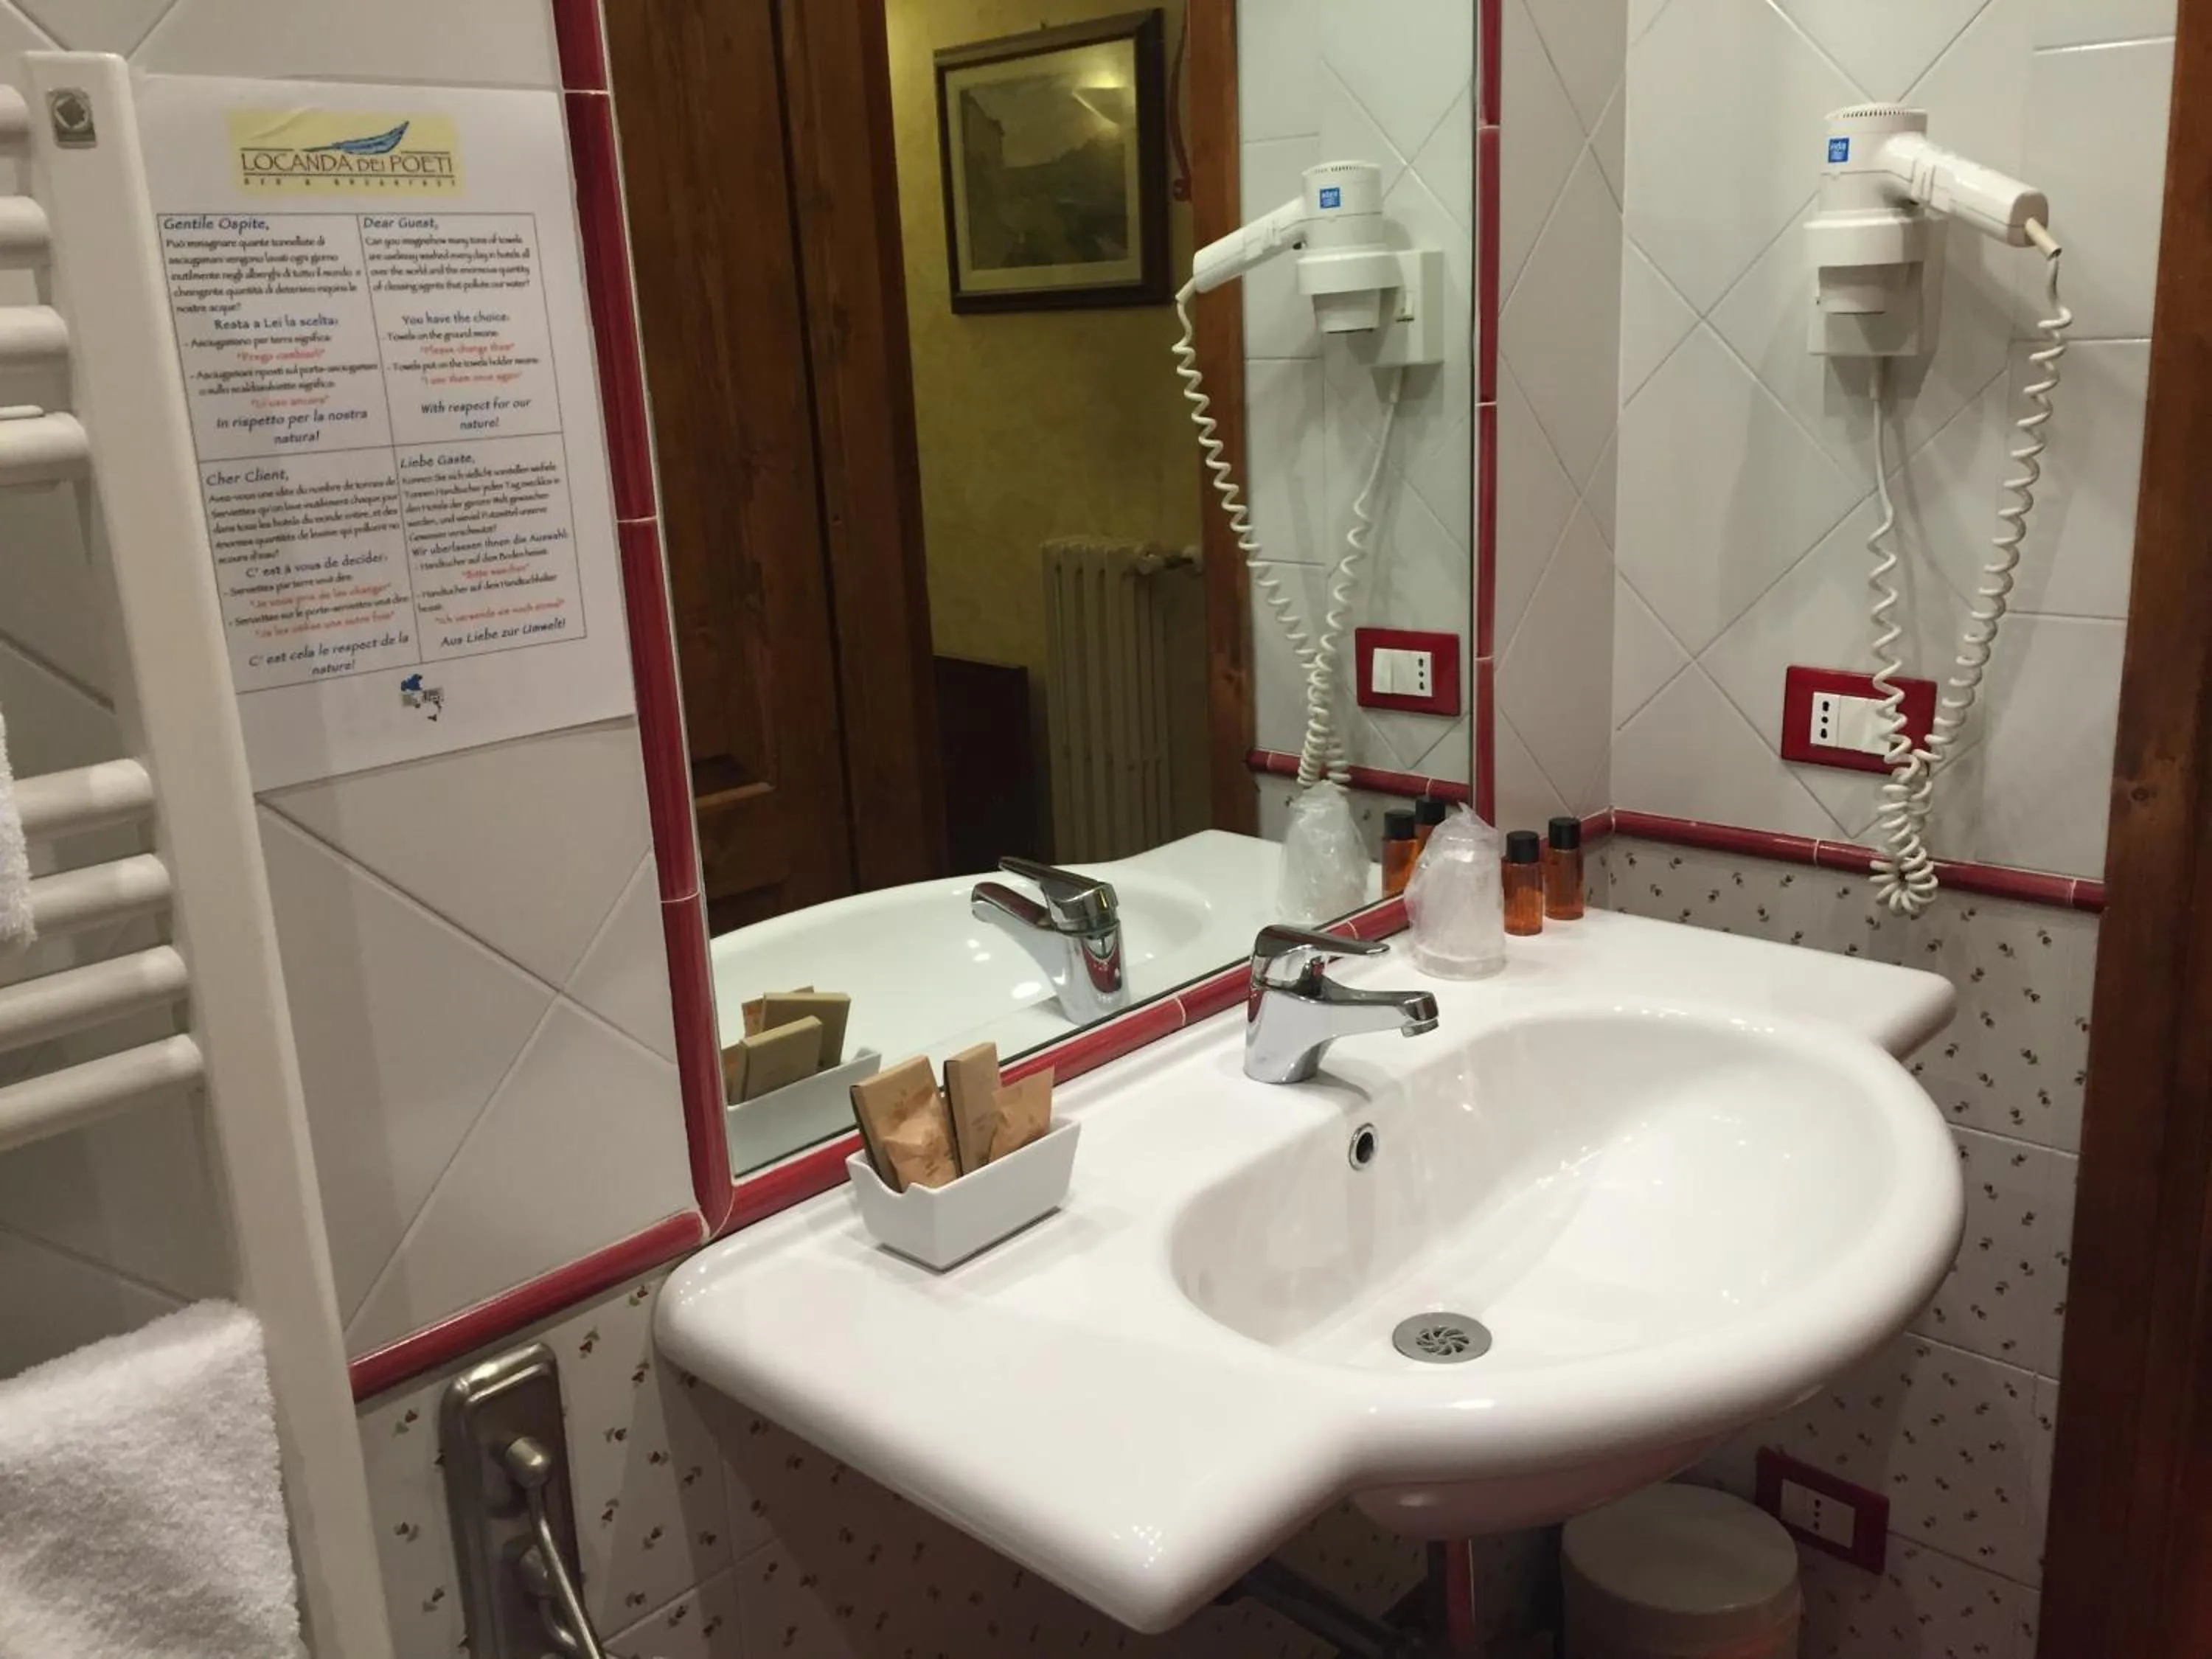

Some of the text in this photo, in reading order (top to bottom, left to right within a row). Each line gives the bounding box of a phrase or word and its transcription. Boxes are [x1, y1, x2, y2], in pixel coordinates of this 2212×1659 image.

[241, 153, 352, 172] LOCANDA
[391, 155, 452, 173] POETI
[164, 216, 269, 235] Gentile Ospite,
[364, 217, 439, 230] Dear Guest,
[214, 319, 249, 330] Resta
[402, 316, 422, 324] You
[425, 311, 451, 324] have
[454, 311, 470, 323] the
[421, 396, 532, 416] With respect for our
[216, 409, 367, 432] In rispetto per la nostra
[400, 453, 434, 468] Liebe
[206, 467, 289, 486] Cher Client,
[263, 566, 281, 577] est
[295, 563, 321, 572] vous
[324, 556, 338, 568] de
[442, 637, 462, 647] Aus
[467, 628, 498, 644] Liebe
[501, 627, 519, 638] zur
[267, 653, 286, 664] est
[290, 647, 315, 660] cela
[318, 644, 329, 655] le
[333, 639, 377, 656] respect
[380, 633, 395, 647] de
[399, 631, 408, 643] la
